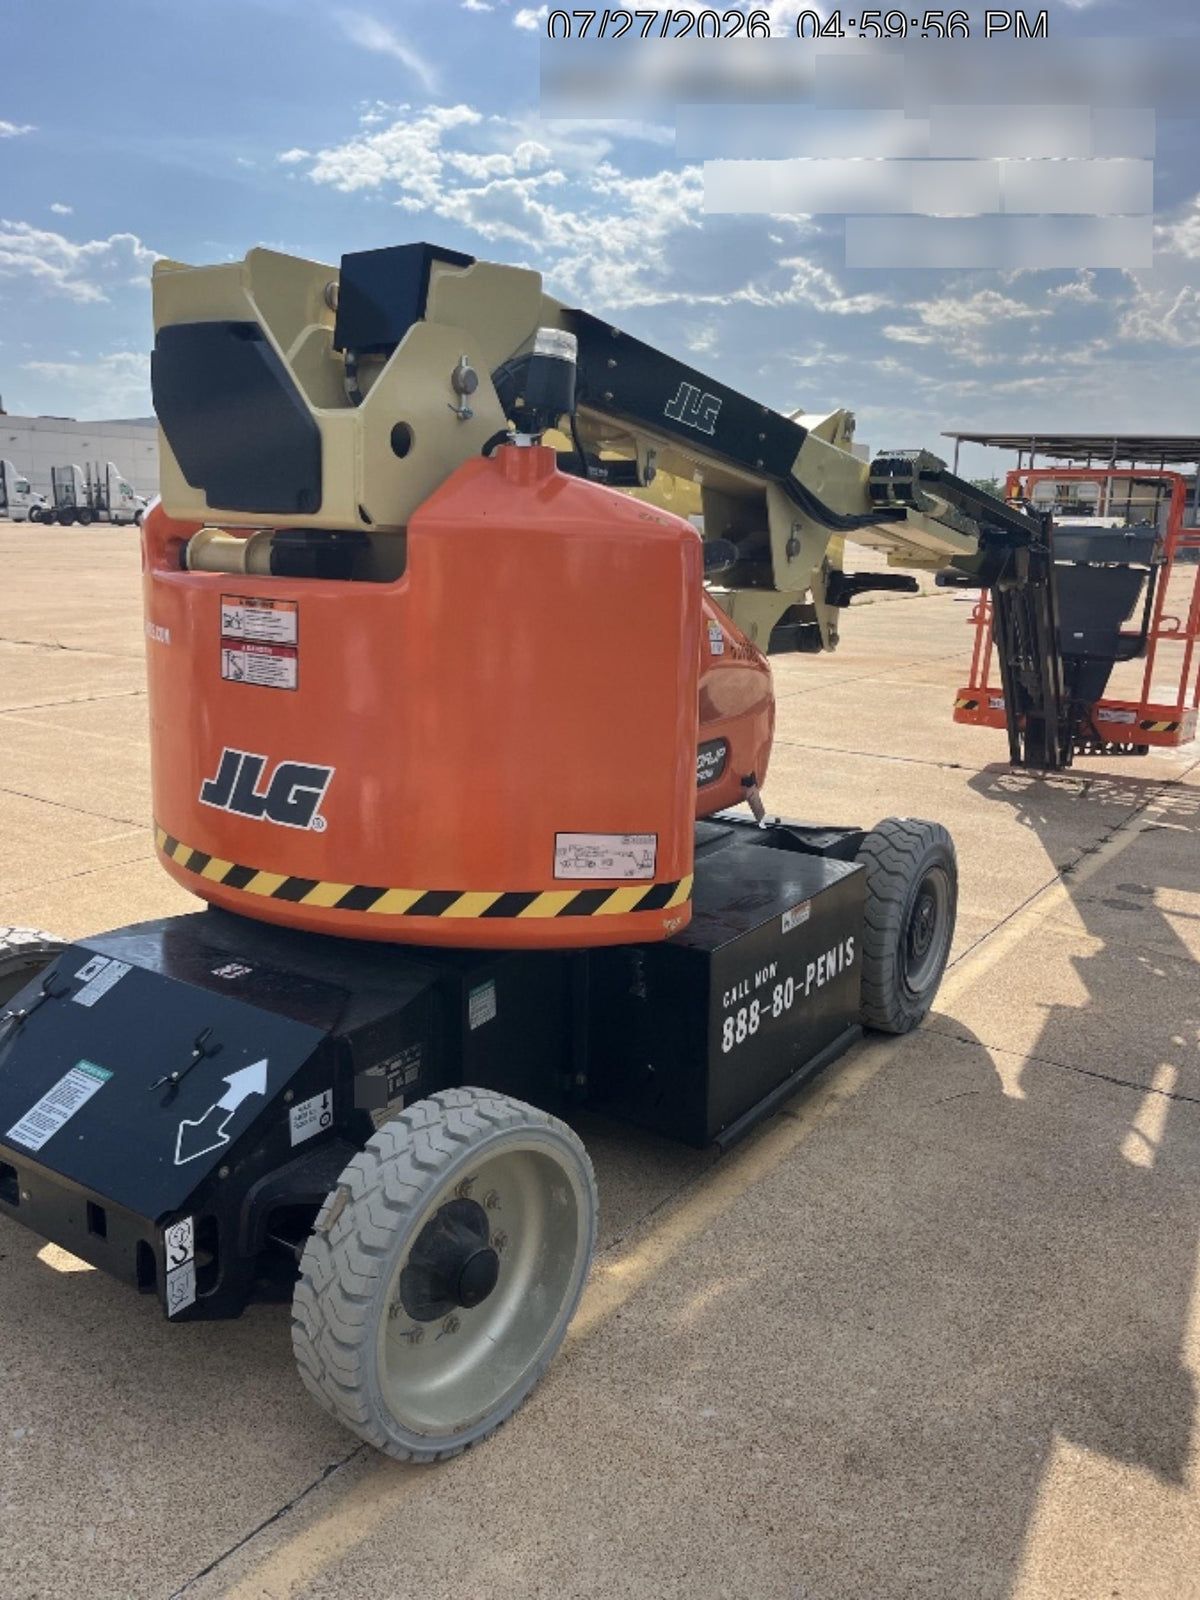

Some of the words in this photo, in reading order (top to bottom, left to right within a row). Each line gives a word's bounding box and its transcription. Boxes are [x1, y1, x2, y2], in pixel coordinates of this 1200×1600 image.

[664, 382, 722, 436] JLG
[199, 746, 336, 831] JLG
[723, 979, 750, 1008] CALL
